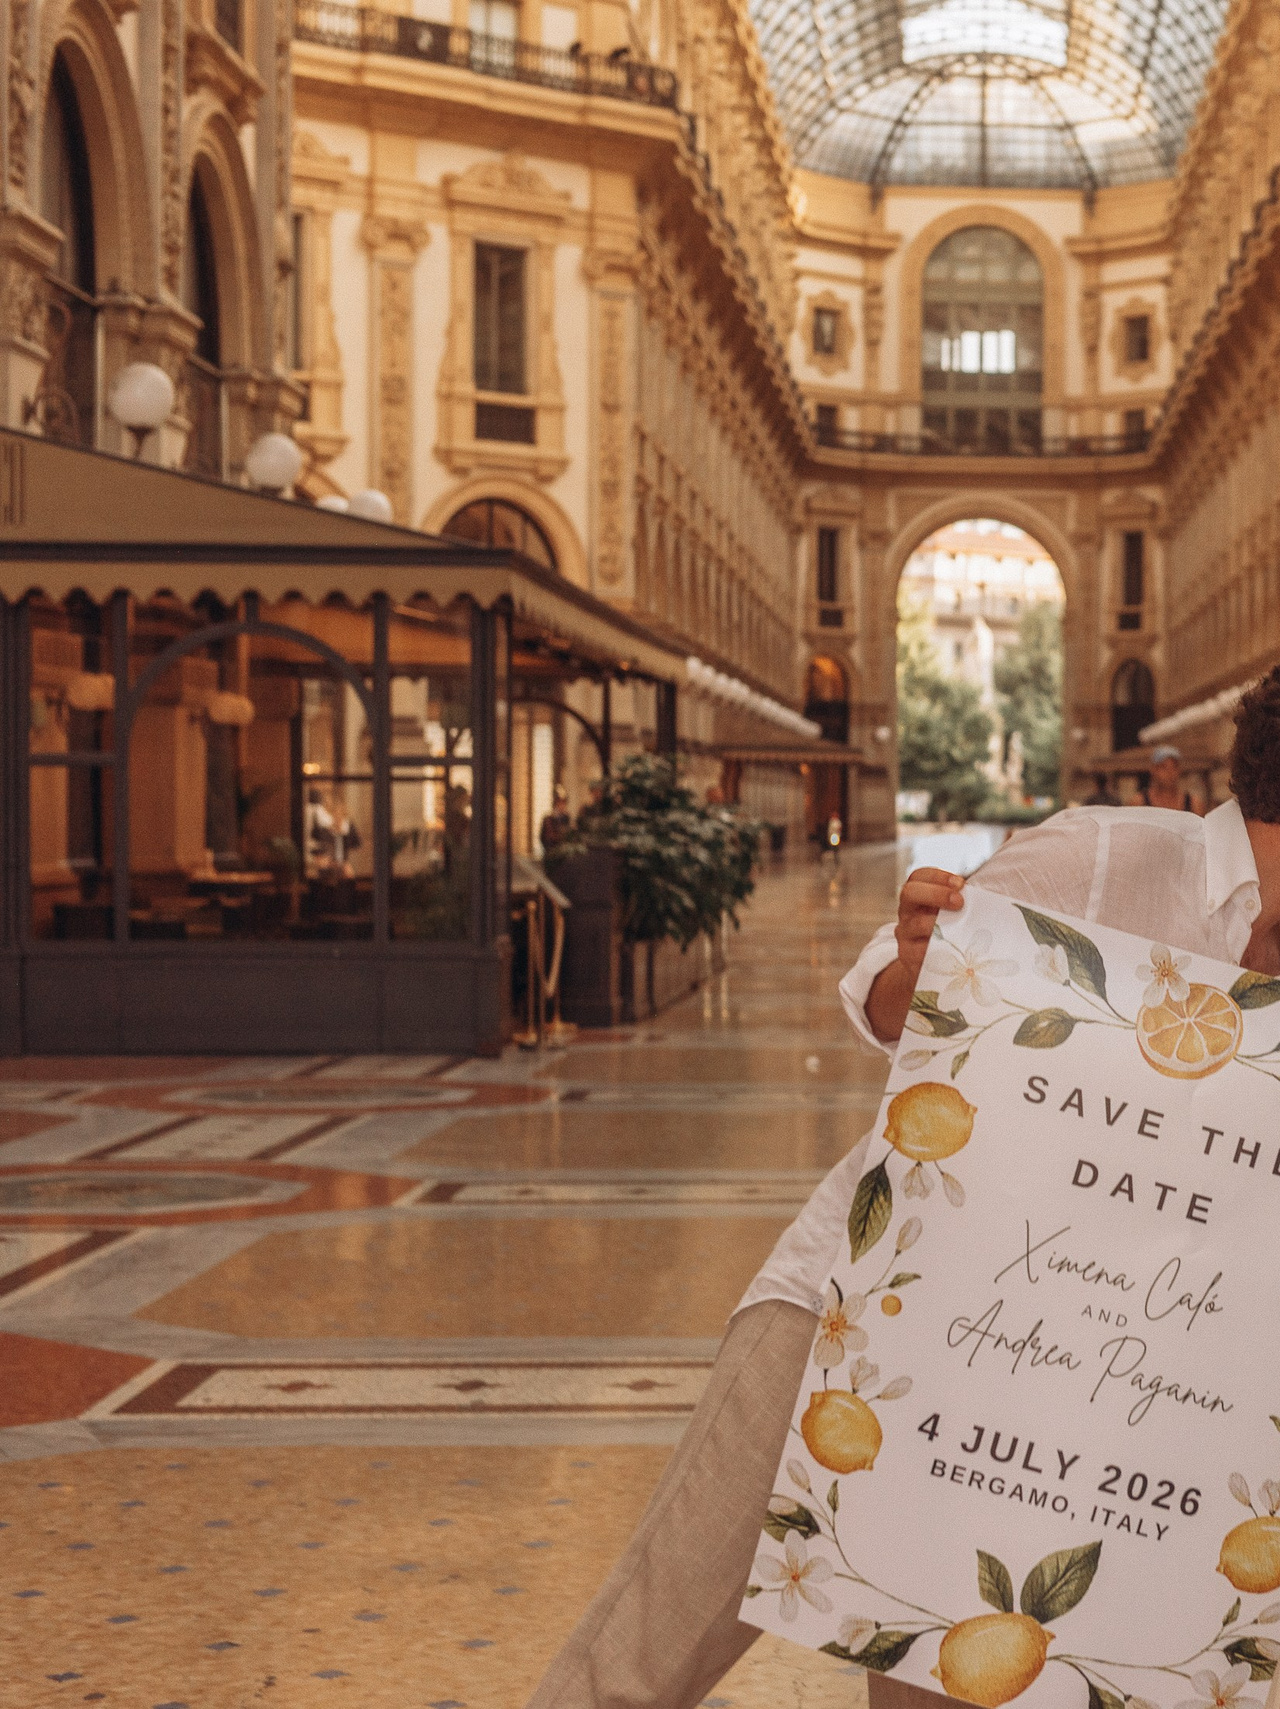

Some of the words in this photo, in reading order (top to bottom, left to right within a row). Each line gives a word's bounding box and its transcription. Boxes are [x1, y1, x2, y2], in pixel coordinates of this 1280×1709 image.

[1022, 1075, 1165, 1140] SAVE
[1071, 1158, 1213, 1225] DATE
[993, 1219, 1136, 1292] Ximena
[1080, 1304, 1128, 1328] AND
[946, 1299, 1082, 1375] Andrea
[1089, 1335, 1233, 1426] Paganin
[917, 1412, 941, 1442] 4
[960, 1424, 1081, 1481] JULY
[1097, 1464, 1202, 1517] 2026
[929, 1458, 1076, 1521] BERGAMO,
[1089, 1505, 1170, 1542] ITALY
